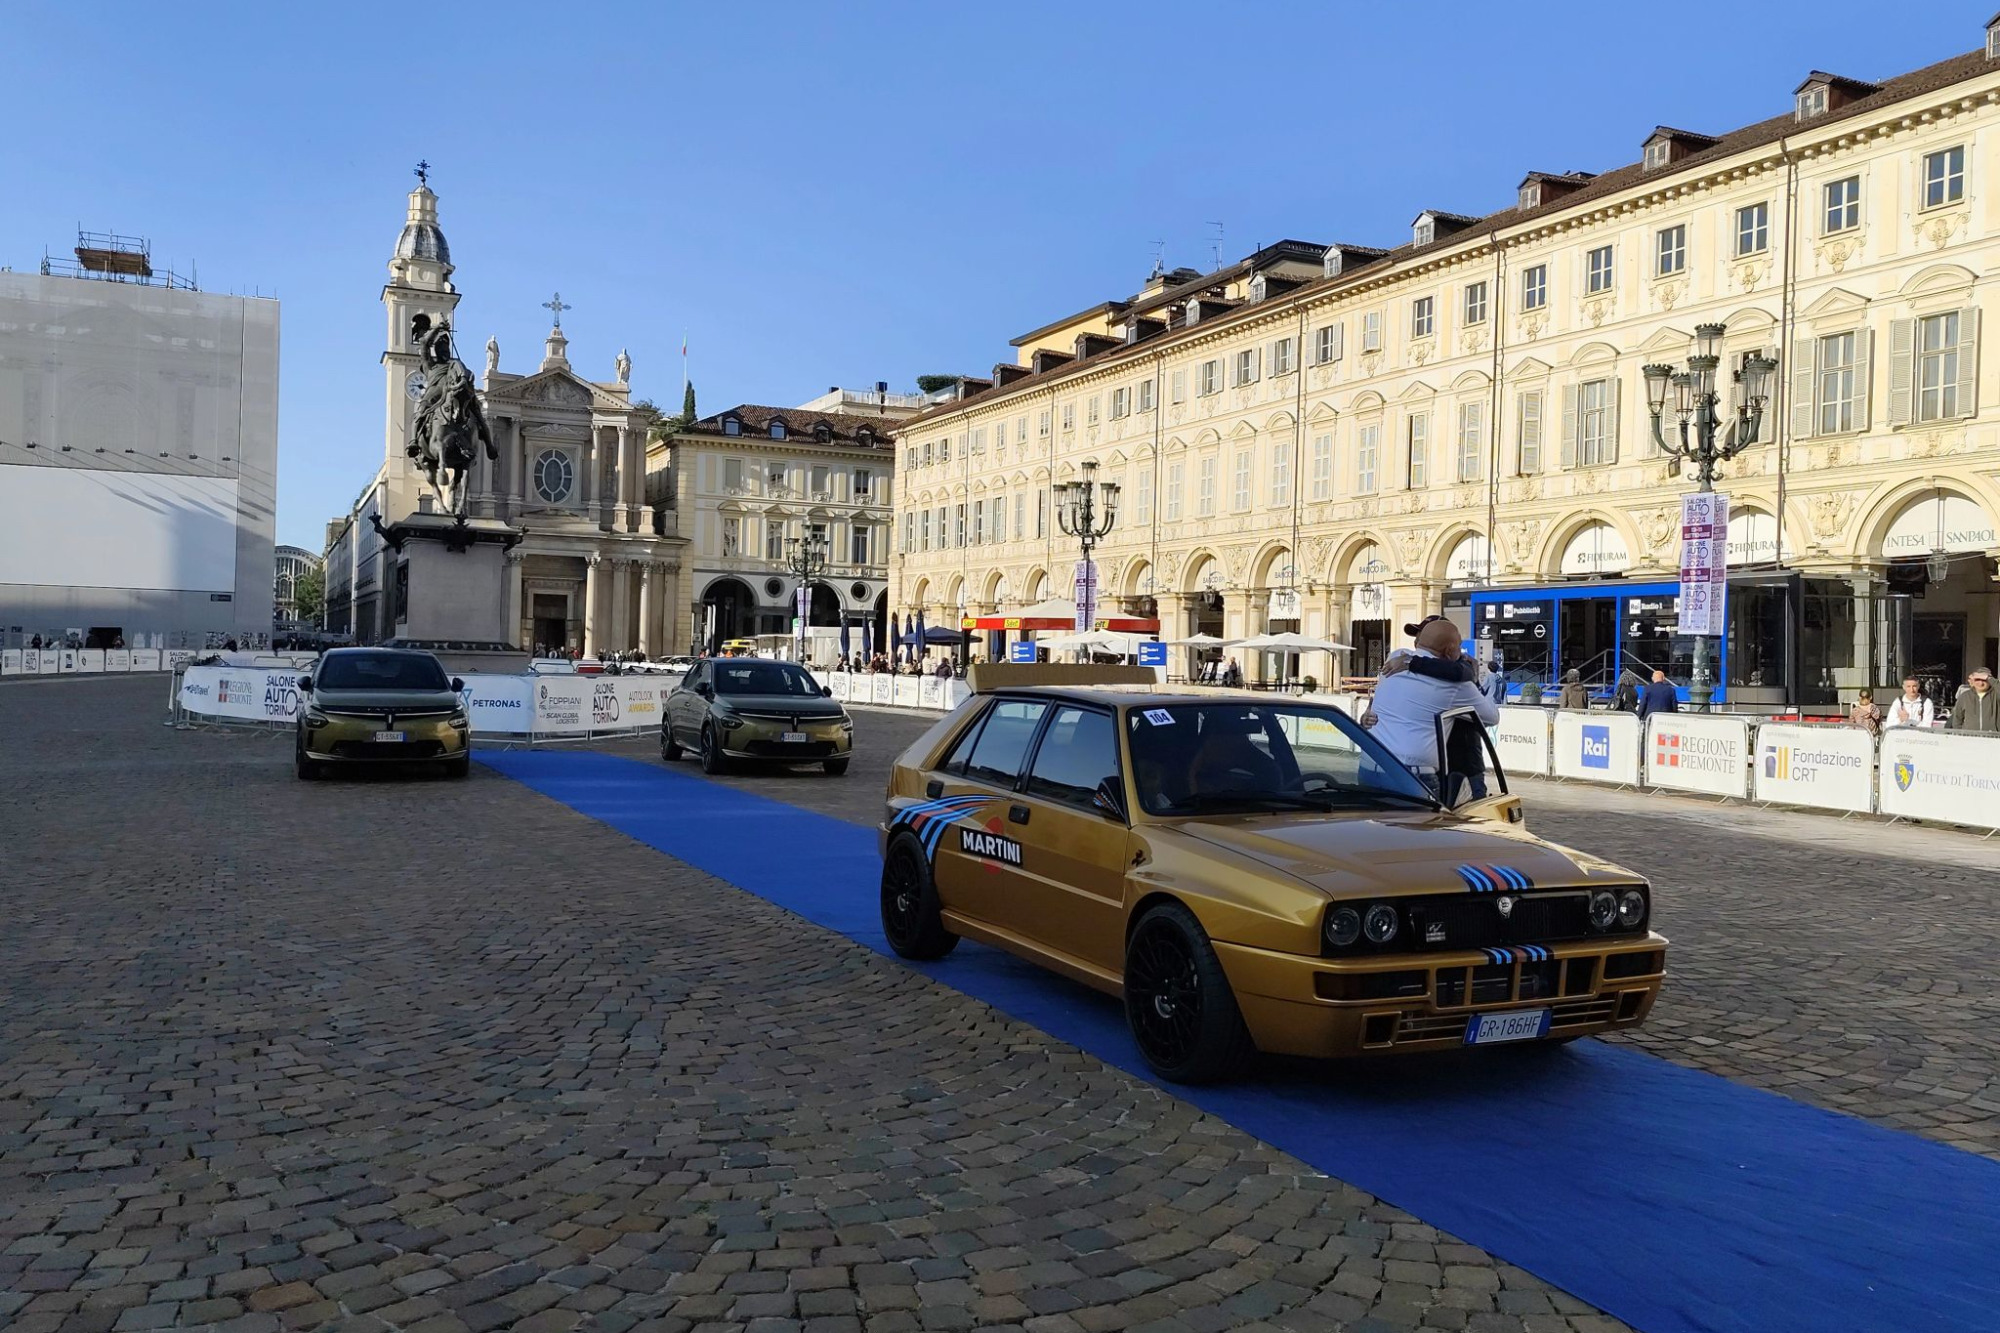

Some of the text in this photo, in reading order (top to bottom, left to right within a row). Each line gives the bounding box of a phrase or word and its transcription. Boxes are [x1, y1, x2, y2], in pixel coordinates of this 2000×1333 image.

[1887, 529, 1997, 547] INTESA SANPAOL
[266, 675, 296, 687] SALONE
[472, 699, 521, 709] PETRONAS
[549, 697, 582, 705] FOPPIANI
[628, 703, 656, 713] AWARDS
[1149, 712, 1171, 724] 104
[1500, 733, 1538, 745] PETRONAS
[1584, 737, 1608, 757] Rai
[1681, 735, 1737, 758] REGIONE
[1681, 754, 1737, 775] PIEMONTE
[1793, 748, 1862, 768] Fondazione
[1792, 767, 1818, 783] CRT
[963, 830, 1021, 863] MARTINI
